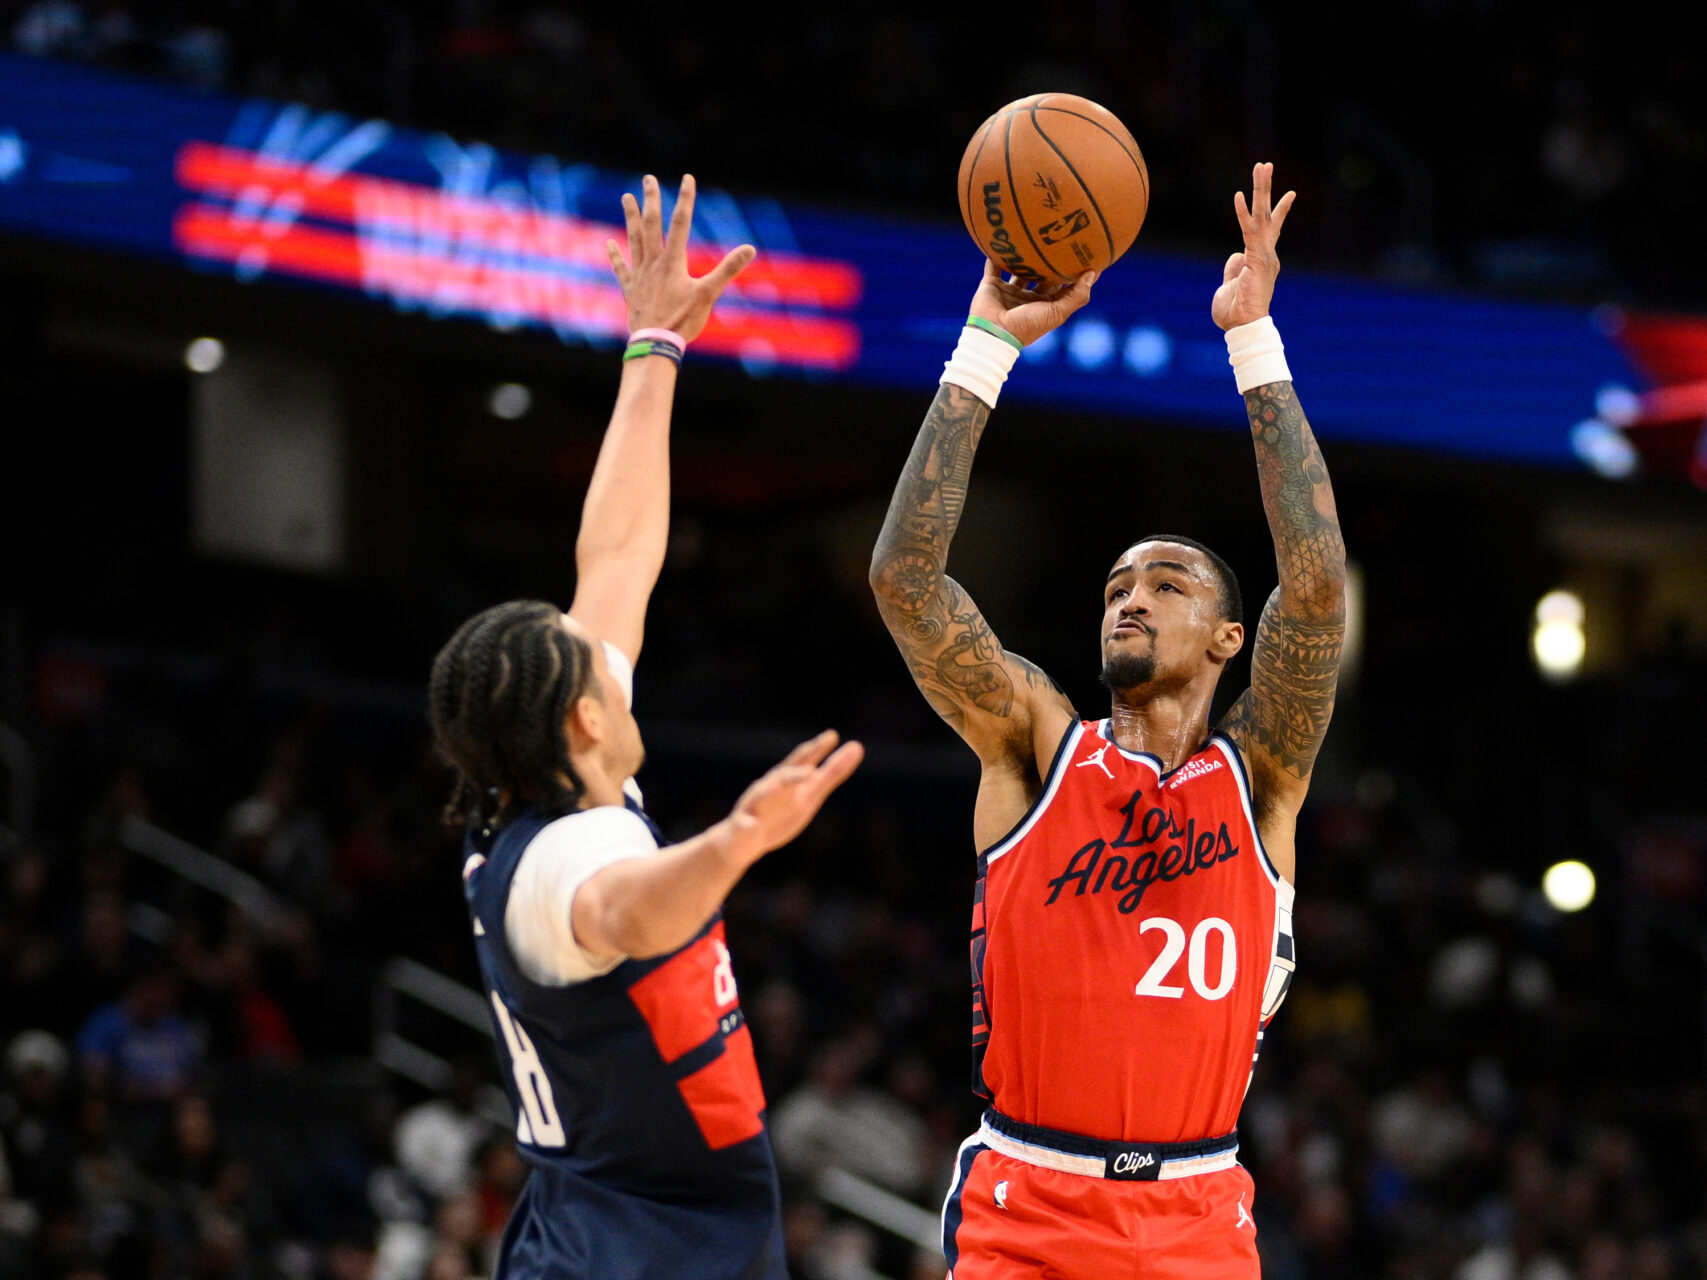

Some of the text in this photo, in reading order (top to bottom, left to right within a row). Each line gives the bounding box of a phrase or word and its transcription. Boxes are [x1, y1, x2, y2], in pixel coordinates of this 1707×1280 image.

[1169, 759, 1223, 790] RWANDA
[1176, 758, 1206, 776] VISIT
[1110, 789, 1184, 849] Los
[1044, 818, 1240, 915] Angeles
[1135, 916, 1237, 1001] 20
[1113, 1151, 1155, 1174] Clips
